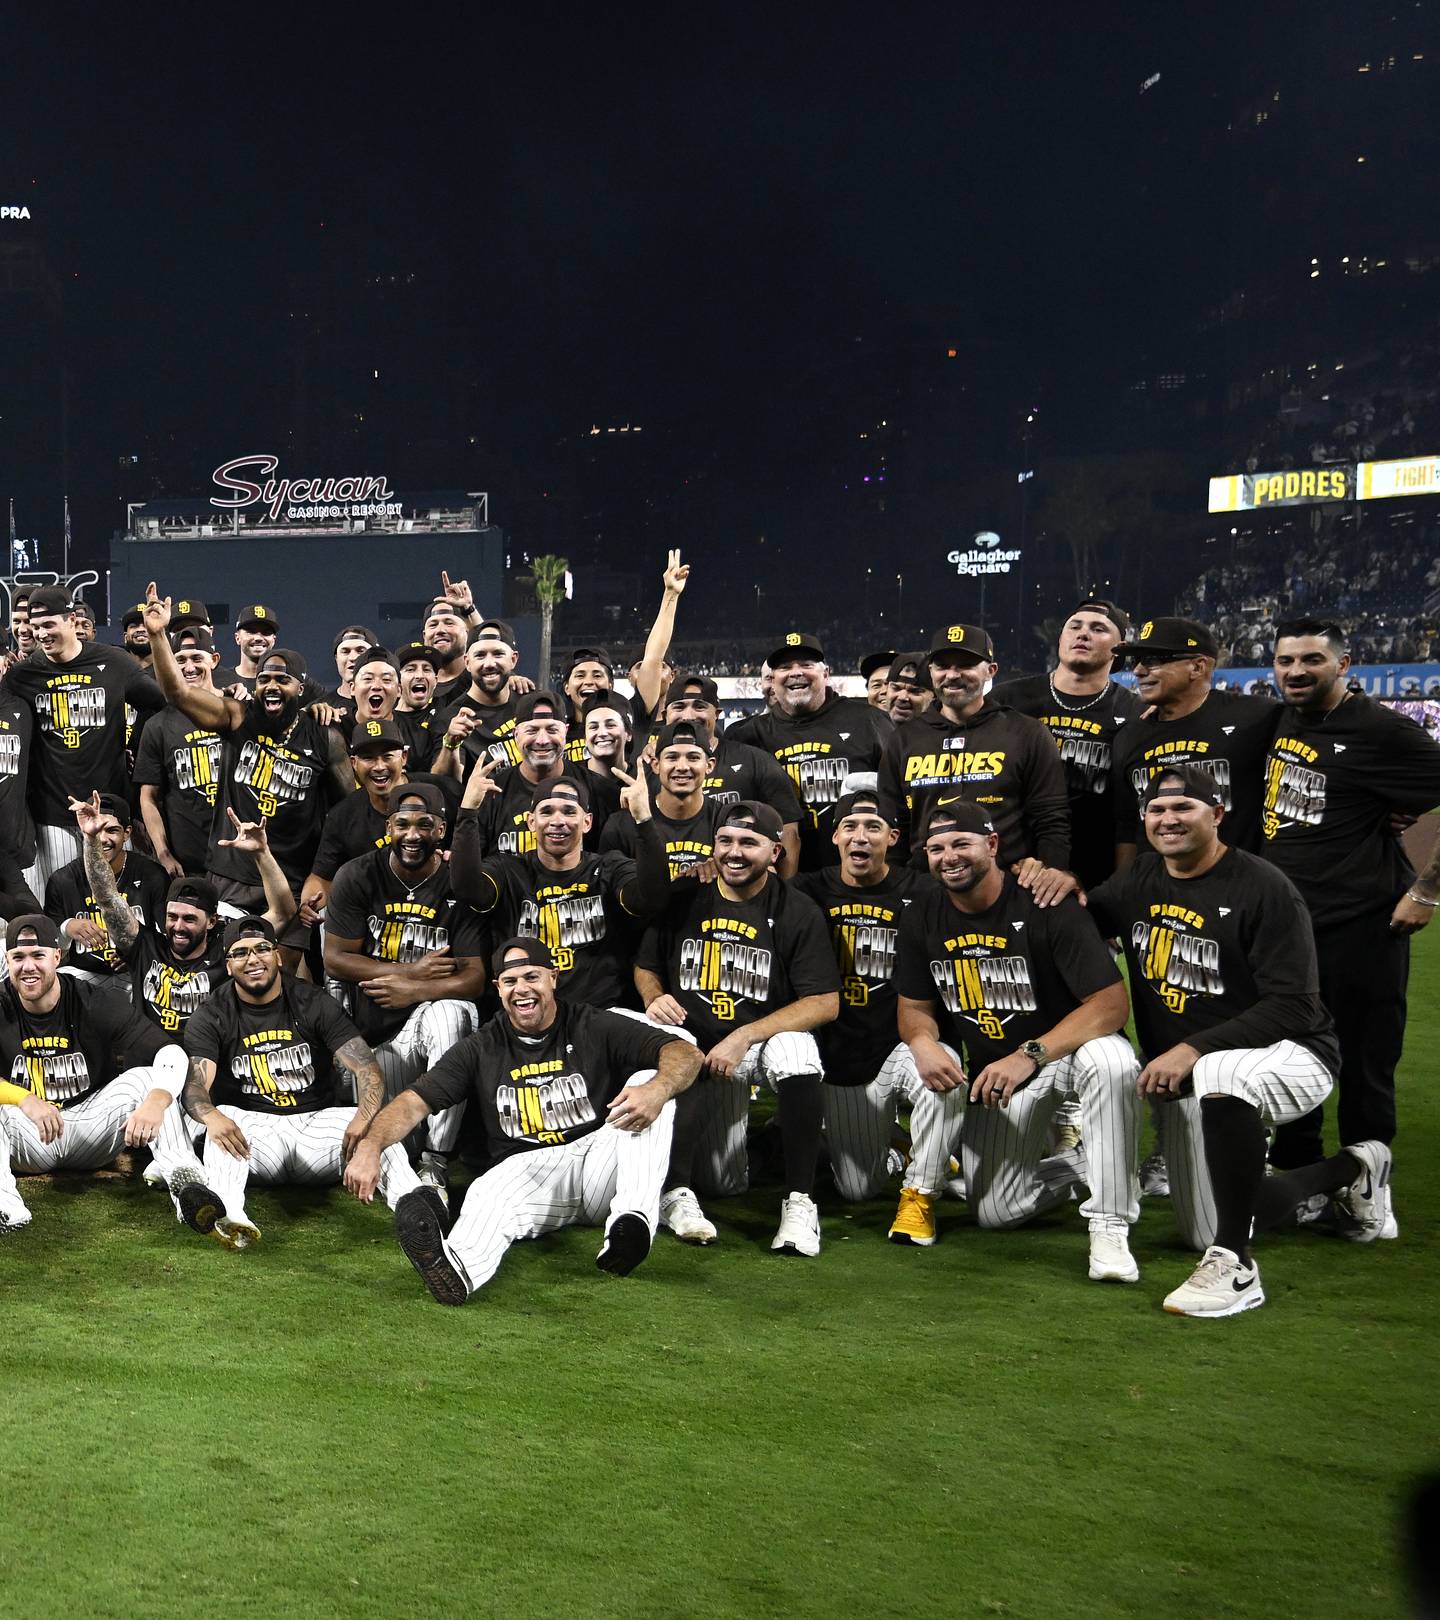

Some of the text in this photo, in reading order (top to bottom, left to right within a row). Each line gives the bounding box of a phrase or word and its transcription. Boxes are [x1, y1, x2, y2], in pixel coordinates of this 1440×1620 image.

[210, 454, 394, 519] Sycuan
[1254, 470, 1345, 506] PADRES
[288, 503, 403, 519] CASINO RESORT
[947, 549, 1021, 564] Gallagher
[957, 562, 1010, 577] Square
[786, 632, 801, 646] SD
[948, 625, 964, 643] SD
[46, 674, 91, 688] PADRES
[35, 687, 106, 732] CLINCHED
[367, 721, 381, 737] SD
[1039, 716, 1101, 735] PADRES
[63, 727, 81, 749] SD
[775, 742, 832, 758] PADRES
[1144, 741, 1210, 760] PADRES
[1275, 738, 1318, 763] PADRES
[234, 740, 312, 801] CLINCHED
[905, 751, 1006, 782] PADRES
[921, 776, 940, 786] TIME
[258, 790, 277, 817] SD
[665, 840, 713, 855] ADRES
[385, 903, 436, 919] PADRES
[829, 903, 893, 922] PADRES
[1150, 904, 1205, 930] PADRES
[944, 934, 1007, 952] PADRES
[550, 946, 574, 972] SD
[1132, 921, 1225, 995] CLINCHED
[680, 938, 771, 1002] CLINCHED
[844, 976, 868, 1007] SD
[930, 956, 1037, 1013] CLINCHED
[712, 991, 736, 1020] SD
[1160, 981, 1186, 1014] SD
[160, 1009, 180, 1031] SD
[978, 1009, 1005, 1040] SD
[22, 1036, 69, 1049] PADRES
[243, 1029, 292, 1048] PADRES
[510, 1060, 564, 1081] PADRES
[496, 1073, 597, 1139] CLINCHED
